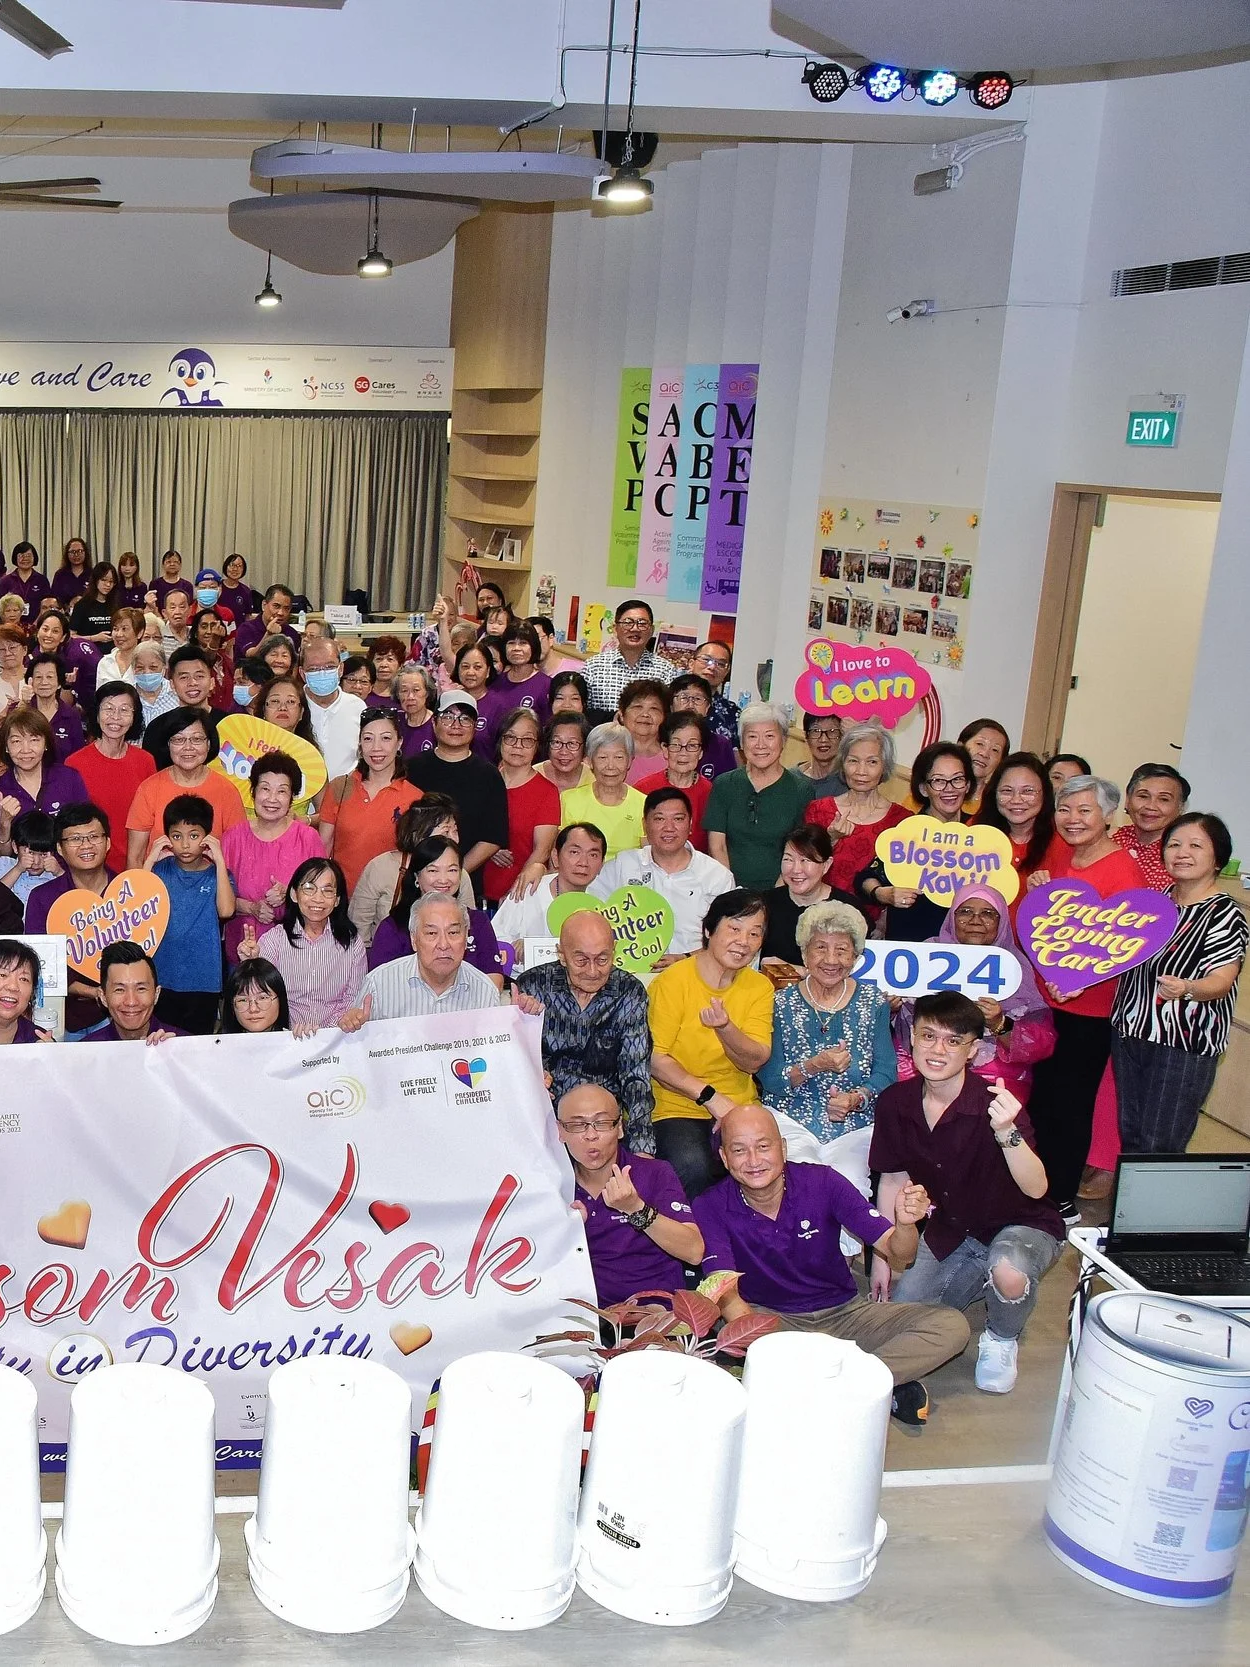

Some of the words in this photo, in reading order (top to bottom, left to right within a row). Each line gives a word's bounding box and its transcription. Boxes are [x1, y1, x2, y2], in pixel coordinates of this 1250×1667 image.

[31, 359, 80, 386] and
[86, 361, 153, 392] Care
[320, 382, 345, 390] NCSS
[356, 381, 368, 389] SG
[1131, 418, 1163, 440] EXIT
[834, 661, 839, 672] I
[842, 658, 872, 672] love
[875, 656, 891, 668] to
[814, 676, 915, 708] Learn
[248, 737, 254, 749] I
[922, 828, 928, 844] I
[932, 831, 960, 846] am
[964, 833, 975, 847] a
[889, 840, 1001, 873] Blossom
[117, 880, 134, 905] A
[622, 892, 638, 912] A
[70, 900, 116, 932] Being
[1048, 888, 1158, 930] Tender
[65, 896, 159, 964] Volunteer
[1030, 915, 1148, 964] Loving
[622, 936, 663, 960] Cool
[1031, 939, 1116, 975] Care
[850, 948, 1006, 995] 2024
[368, 1048, 394, 1059] Awarded
[394, 1044, 424, 1055] President
[423, 1041, 453, 1053] Challenge
[453, 1039, 471, 1050] 2019,
[472, 1036, 488, 1047] 2021
[488, 1036, 495, 1044] &
[495, 1033, 511, 1044] 2023
[301, 1056, 332, 1069] Supported
[332, 1055, 340, 1065] by
[400, 1079, 415, 1089] GIVE
[403, 1088, 417, 1097] LIVE
[454, 1089, 492, 1100] PRESIDENT'S
[455, 1096, 493, 1106] CHALLENGE
[7, 1126, 22, 1134] 2022
[138, 1143, 540, 1313] Vesak
[56, 1344, 104, 1377] in
[125, 1322, 375, 1374] Diversity
